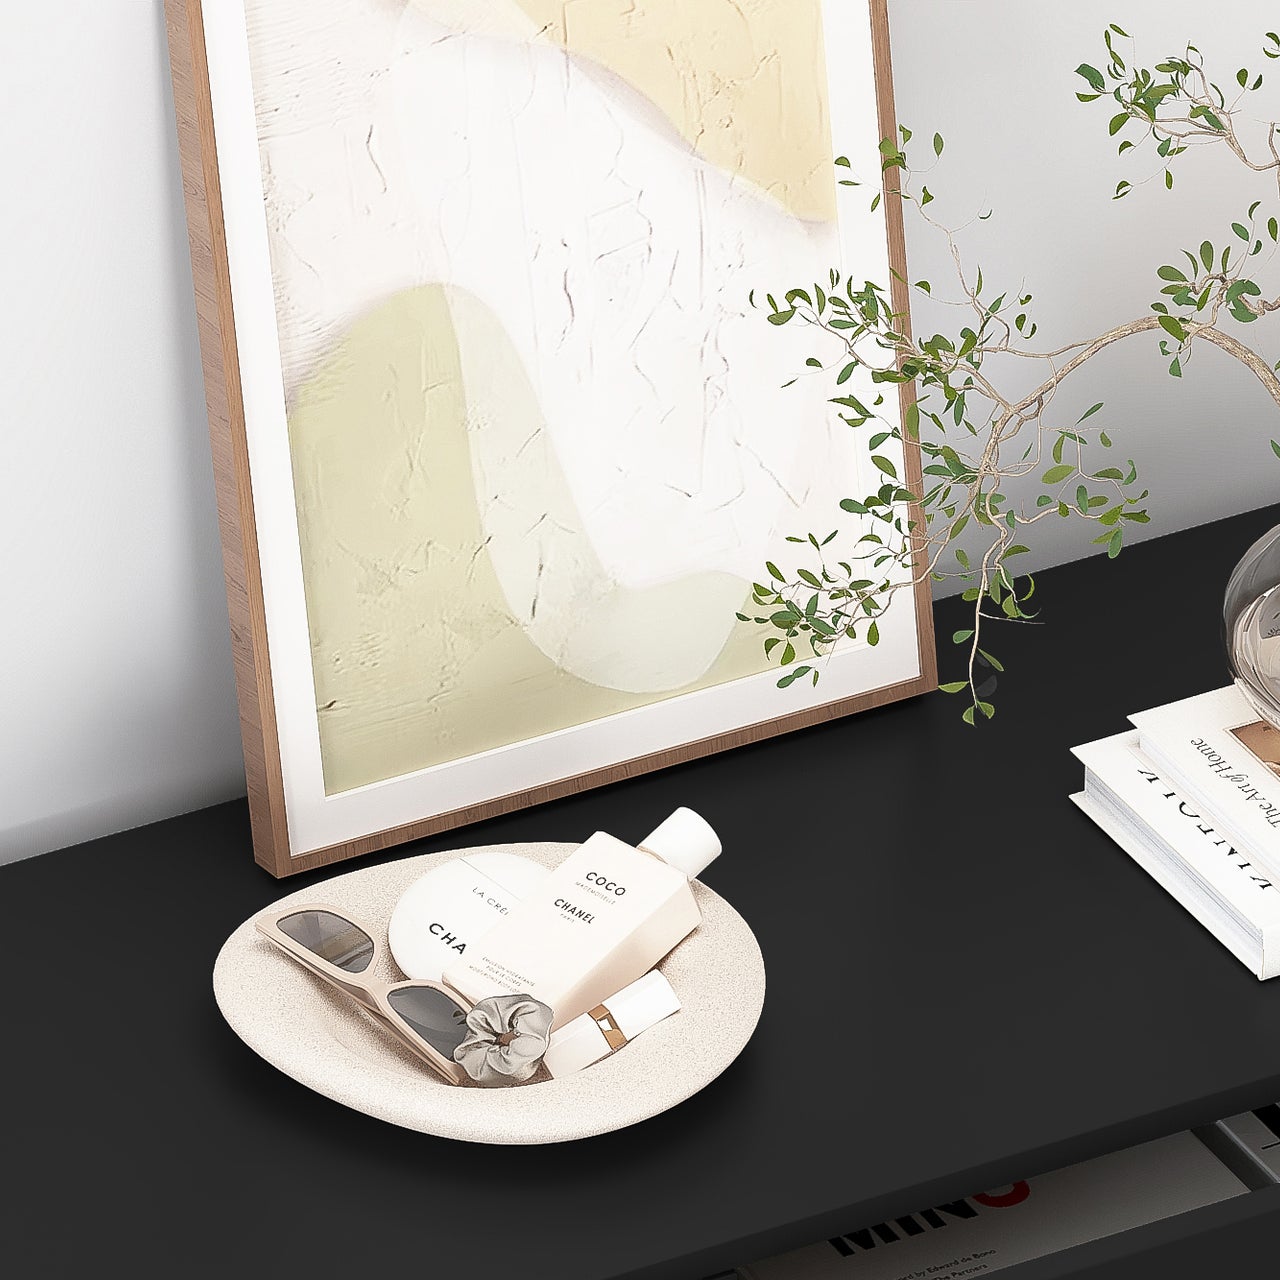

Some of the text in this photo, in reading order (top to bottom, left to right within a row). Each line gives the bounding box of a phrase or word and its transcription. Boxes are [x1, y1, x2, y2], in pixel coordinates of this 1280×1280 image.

[1190, 737, 1233, 774] Home
[1219, 773, 1249, 783] of
[1237, 783, 1266, 801] Art
[472, 886, 485, 898] LA
[585, 871, 626, 896] COCO
[554, 898, 595, 924] CHANEL
[428, 922, 467, 955] CHA
